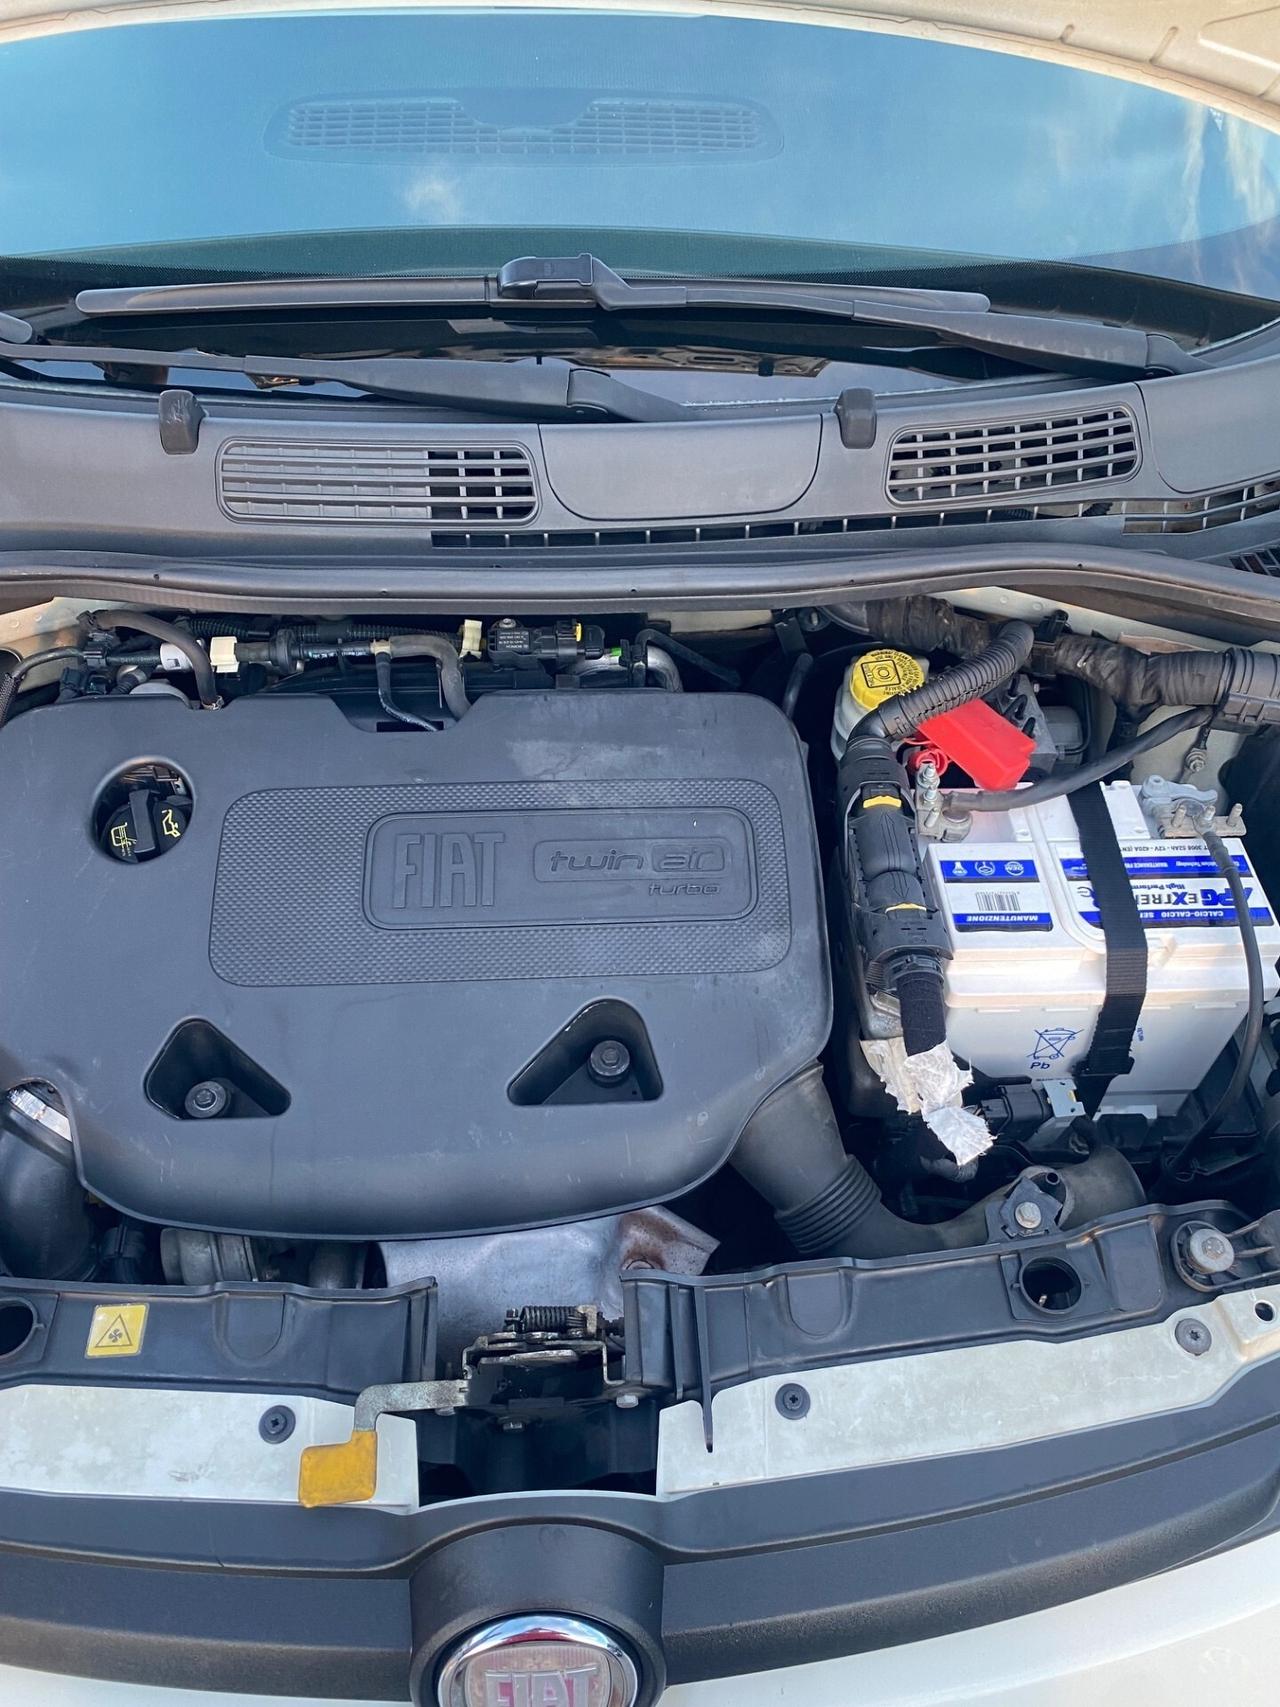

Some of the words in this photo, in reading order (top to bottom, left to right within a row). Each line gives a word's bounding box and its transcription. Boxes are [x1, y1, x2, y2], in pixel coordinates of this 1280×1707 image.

[393, 831, 506, 908] FIAT
[550, 848, 645, 872] twin
[661, 847, 721, 871] air
[648, 882, 720, 896] turbo
[484, 1664, 598, 1707] FIAT
